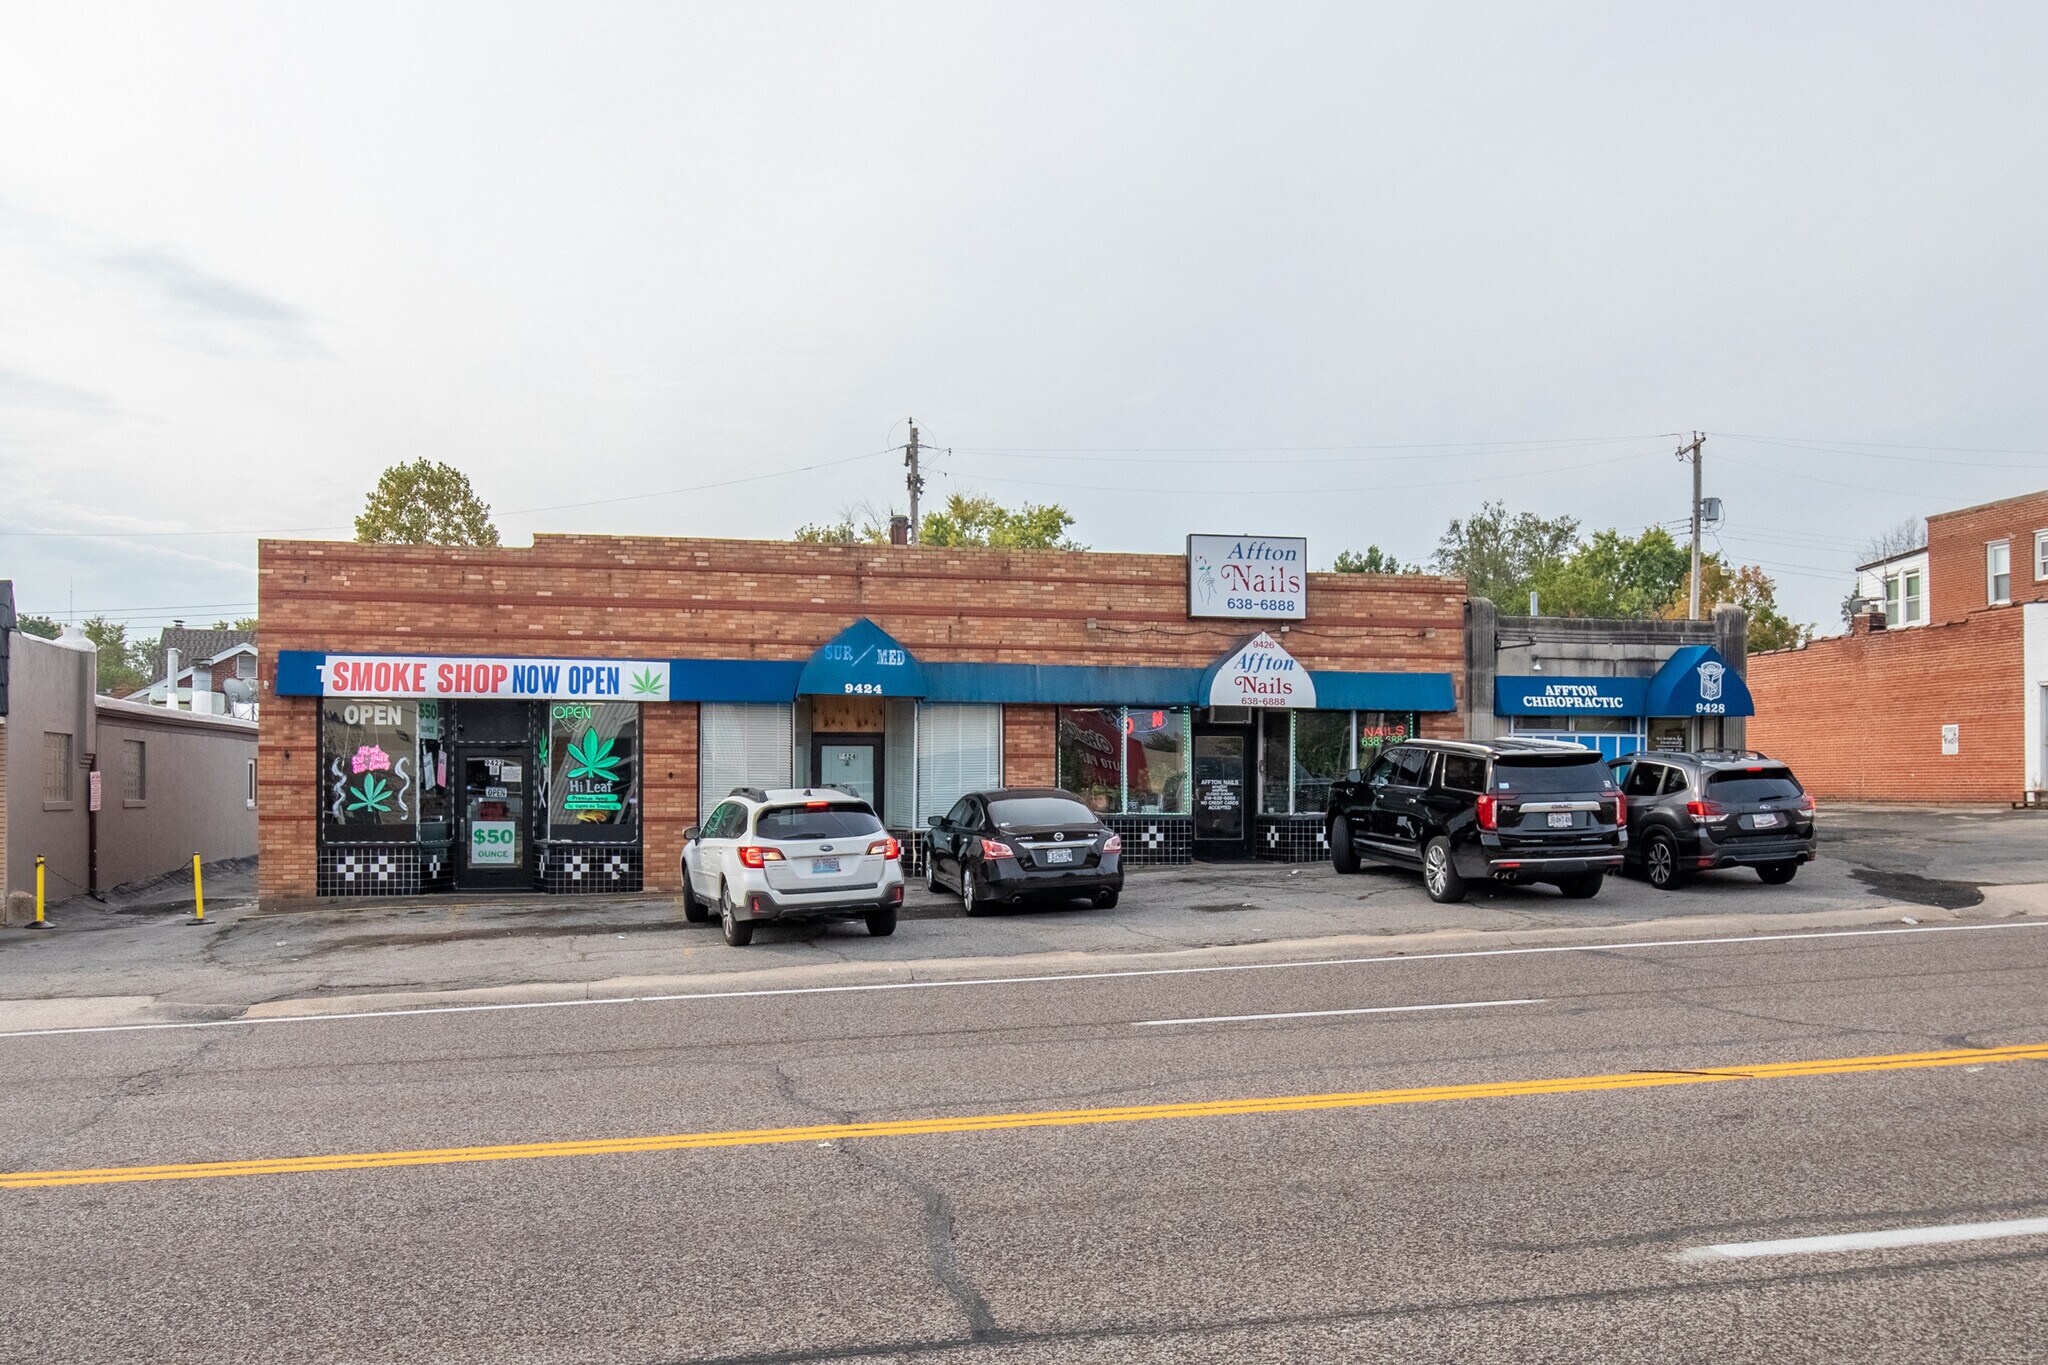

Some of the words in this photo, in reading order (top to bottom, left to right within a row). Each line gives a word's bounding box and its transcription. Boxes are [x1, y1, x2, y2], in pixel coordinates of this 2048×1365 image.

[1227, 541, 1297, 561] Affton
[1220, 564, 1300, 594] Nails
[1227, 598, 1295, 612] 638-6888
[1252, 640, 1275, 649] 9426
[1234, 652, 1295, 674] Affton
[332, 661, 427, 692] SMOKE
[437, 663, 508, 693] SHOP
[512, 664, 560, 694] NOW
[568, 666, 620, 695] OPEN
[844, 683, 882, 694] 9424
[1234, 675, 1293, 695] Nails
[1545, 684, 1598, 697] AFFTON
[1241, 696, 1286, 706] 638-6888
[1523, 695, 1624, 708] CHIROPRACTIC
[1695, 702, 1726, 713] 9428
[344, 705, 401, 725] OPEN
[419, 703, 437, 719] $50
[553, 706, 591, 719] OPEN
[421, 725, 435, 734] OUNCE
[1364, 725, 1405, 737] NAILS
[569, 780, 583, 792] Hi
[586, 780, 612, 793] Leaf
[474, 829, 513, 844] $50
